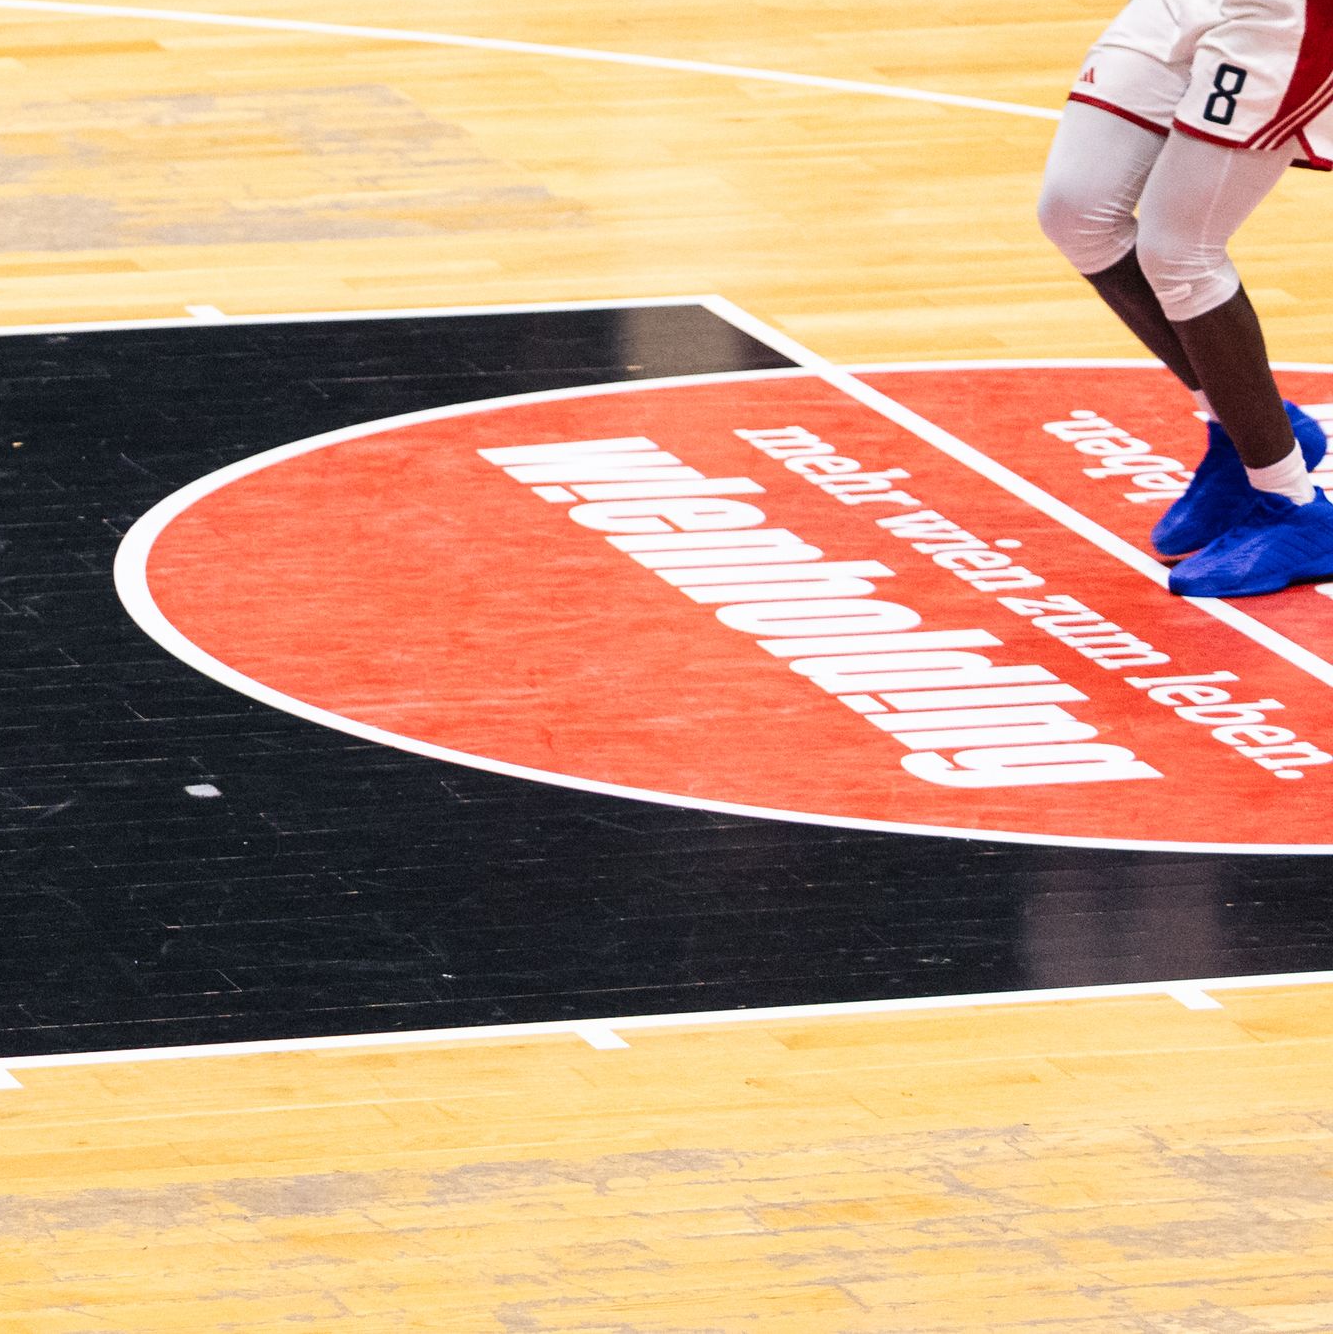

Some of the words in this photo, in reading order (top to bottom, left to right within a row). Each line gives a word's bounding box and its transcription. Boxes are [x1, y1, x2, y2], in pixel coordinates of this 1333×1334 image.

[1203, 62, 1248, 126] 8
[733, 425, 923, 506] mehr
[874, 509, 1046, 592] wien
[996, 594, 1171, 670] zum
[1123, 670, 1333, 780] leben.
